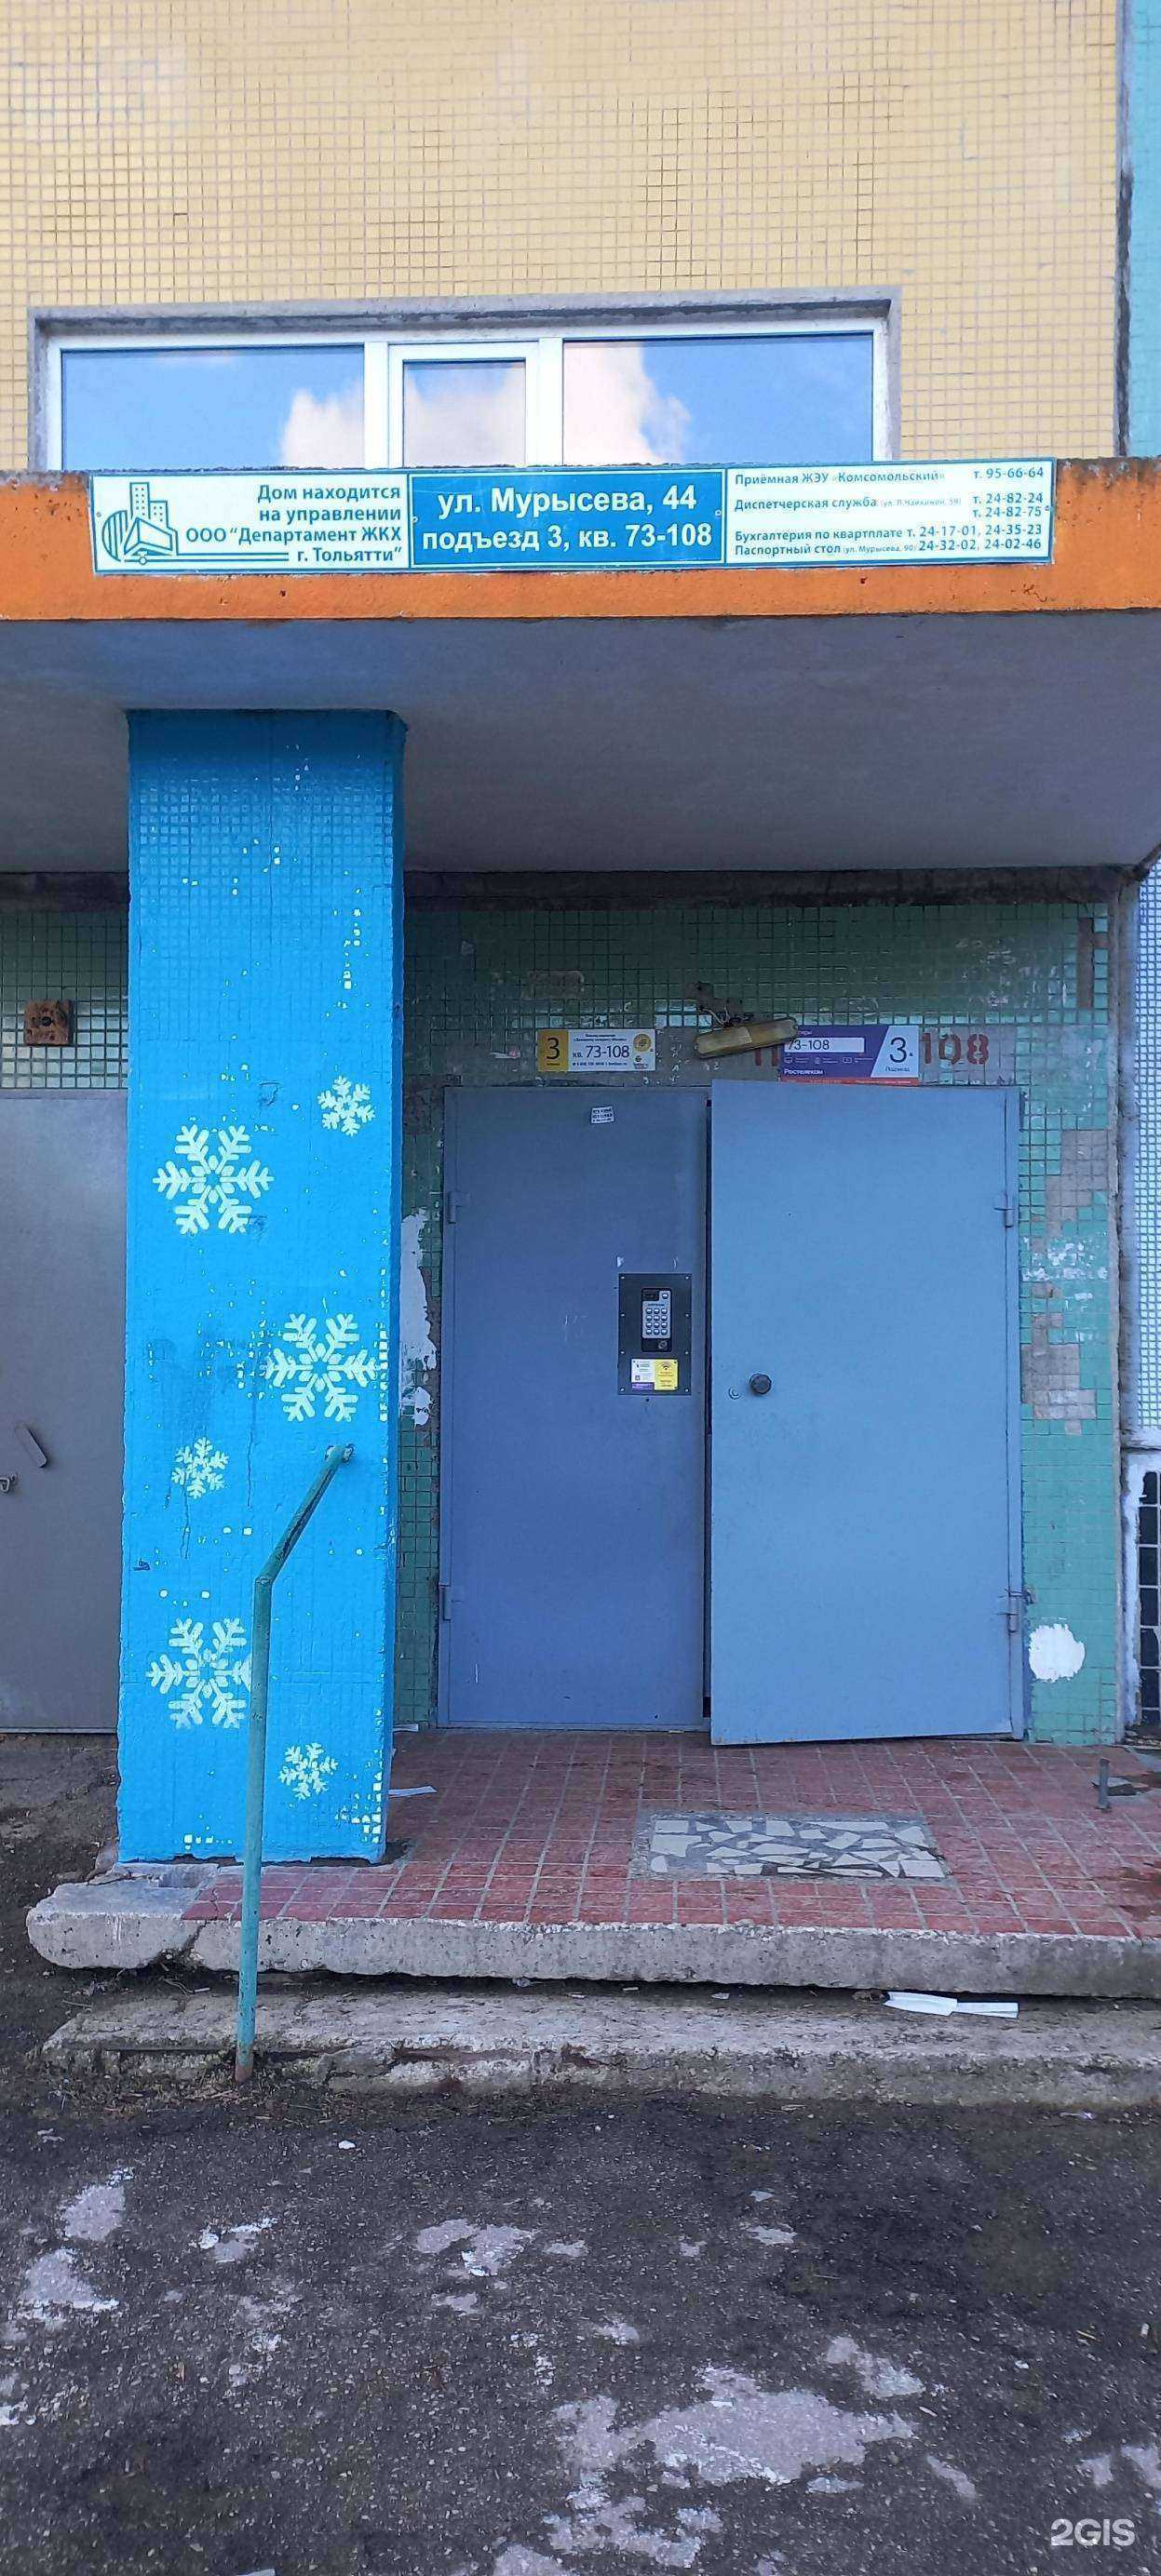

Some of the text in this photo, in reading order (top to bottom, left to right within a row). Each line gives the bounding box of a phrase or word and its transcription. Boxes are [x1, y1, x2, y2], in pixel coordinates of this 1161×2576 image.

[735, 473, 799, 487] Приёмная
[802, 472, 829, 484] ЖЭУ
[986, 467, 1044, 478] 95-66-64
[258, 484, 400, 503] Дом находится
[437, 484, 697, 520] ул. Мурысева, 44
[735, 499, 829, 512] Диспетчерская
[831, 496, 877, 510] служба
[985, 492, 1043, 503] 24-82-24
[260, 508, 401, 525] на управлении
[984, 506, 1042, 517] 24-82-75
[186, 527, 227, 543] ООО
[361, 526, 402, 542] ЖКХ
[422, 522, 713, 554] подъезд 3, кв. 73-108
[736, 530, 812, 543] Бухгалтерия
[815, 530, 830, 540] по
[832, 529, 903, 541] квартплате
[919, 525, 981, 537] 24-17-01,
[985, 524, 1042, 535] 24-35-23
[298, 551, 309, 562] г.
[736, 543, 811, 557] Паспортный
[814, 544, 841, 554] стол
[918, 539, 980, 552] 24-32-02,
[984, 538, 1042, 550] 24-02-46
[546, 1037, 561, 1061] 3
[585, 1044, 630, 1059] 73-108
[889, 1036, 908, 1064] 3
